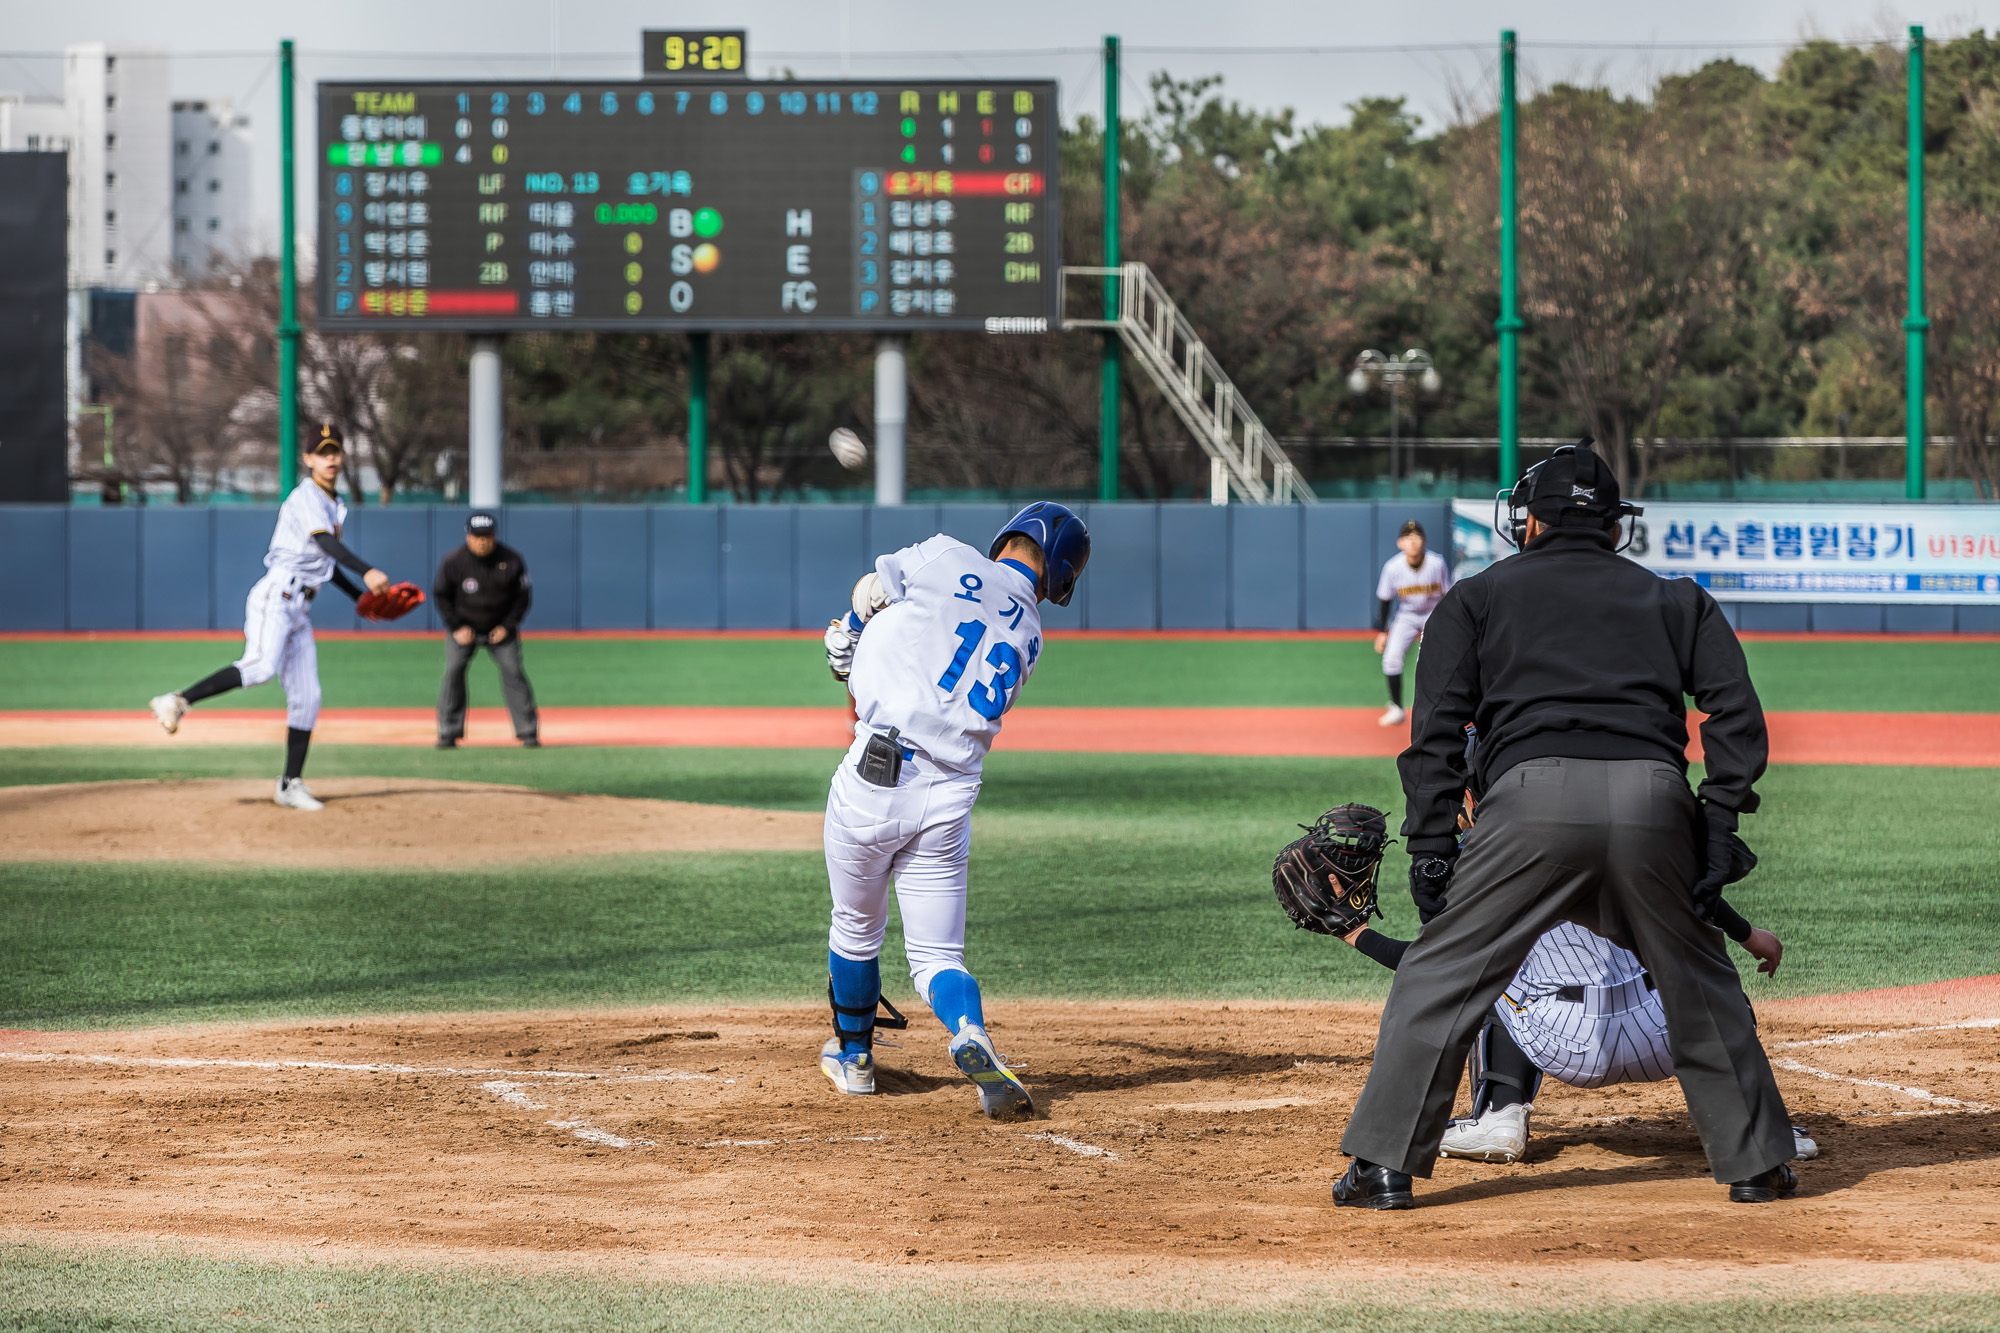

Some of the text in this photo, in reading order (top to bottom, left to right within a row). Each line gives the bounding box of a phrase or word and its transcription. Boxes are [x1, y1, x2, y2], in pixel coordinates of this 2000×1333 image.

[664, 36, 741, 70] 9:20
[353, 90, 1033, 115] TEAM 1 2 3 4 5 6 7 8 9 10 11 12 R H E B
[455, 118, 472, 138] 0
[492, 119, 508, 138] 0
[901, 118, 916, 137] 0
[941, 118, 954, 136] 1
[1015, 118, 1032, 137] 0
[455, 145, 471, 163] 4
[492, 145, 508, 163] 0
[901, 145, 915, 162] 4
[941, 144, 954, 163] 1
[1016, 143, 1031, 163] 3
[336, 173, 352, 196] 8
[479, 173, 504, 194] LF
[572, 172, 599, 193] 13
[860, 172, 878, 196] 9
[1004, 172, 1034, 195] CF
[336, 202, 352, 225] 9
[479, 203, 507, 223] RF
[669, 208, 692, 237] B
[786, 209, 812, 236] H
[862, 202, 876, 226] 1
[1005, 203, 1033, 224] RF
[338, 232, 350, 257] 1
[486, 232, 504, 252] P
[624, 232, 642, 254] 0
[861, 231, 878, 254] 2
[1005, 232, 1034, 253] 2B
[671, 244, 692, 275] S
[787, 245, 810, 274] E
[336, 261, 352, 286] 2
[480, 262, 508, 284] 2B
[625, 262, 642, 285] 0
[861, 260, 877, 284] 3
[1005, 262, 1040, 282] DH
[624, 291, 642, 314] 0
[782, 281, 817, 312] FC
[1663, 521, 1916, 562] 선수촌병원장기
[937, 618, 1021, 721] 13
